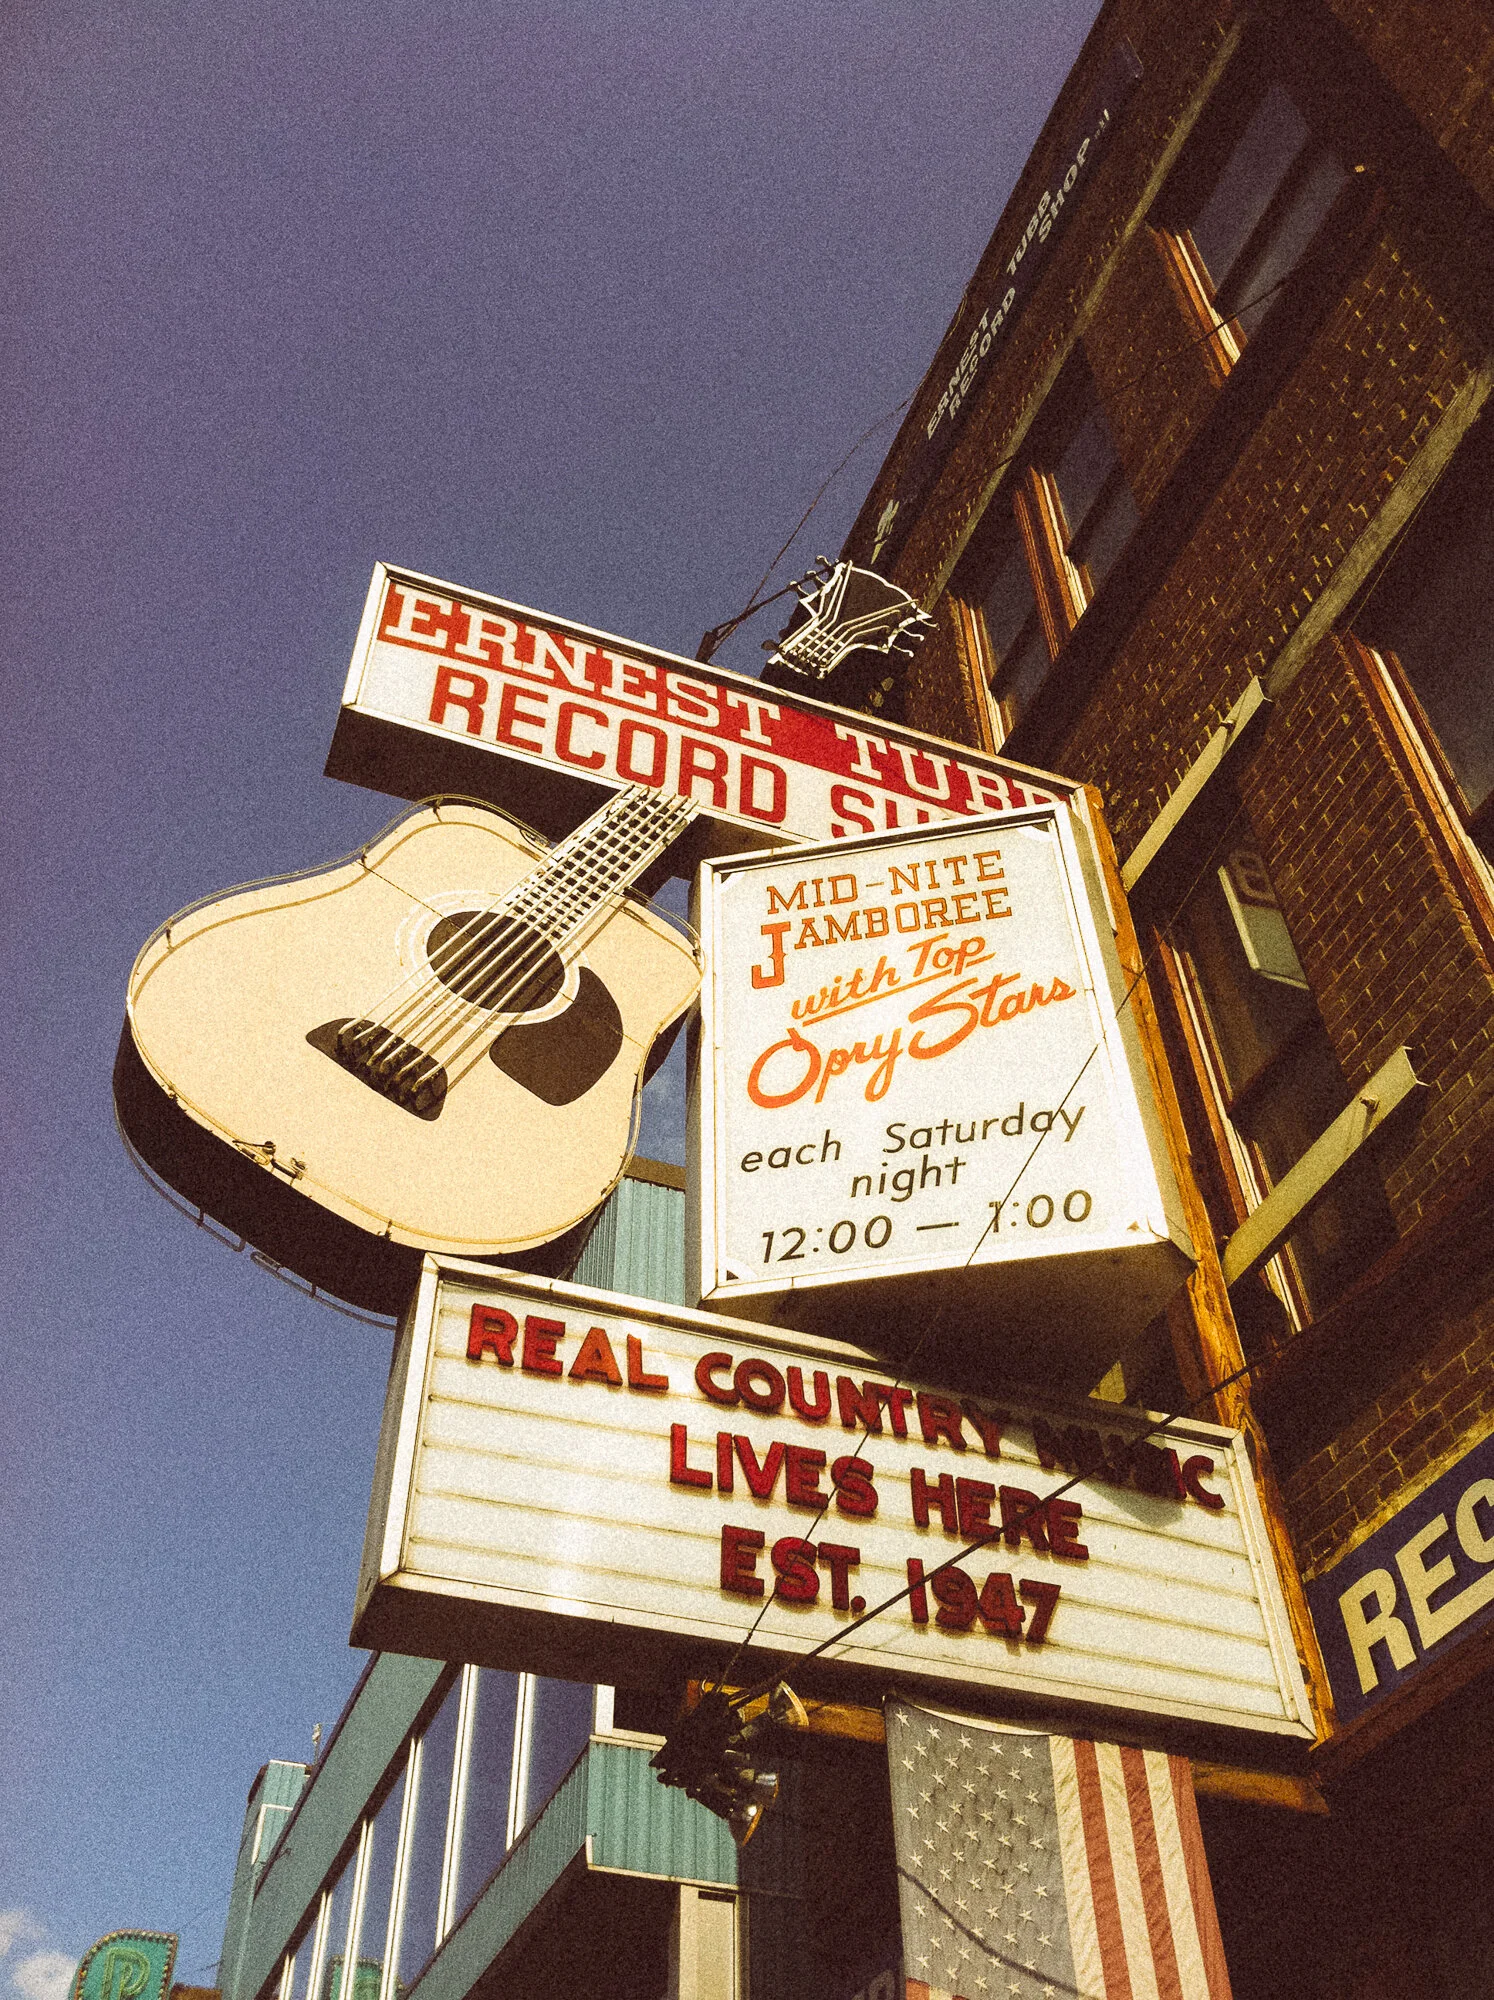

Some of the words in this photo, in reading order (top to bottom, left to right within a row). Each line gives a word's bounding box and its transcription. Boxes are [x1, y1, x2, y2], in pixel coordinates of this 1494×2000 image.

[927, 307, 989, 440] ERNEST
[1007, 191, 1051, 275] TUBB
[949, 287, 1016, 419] RECORD
[1039, 138, 1090, 244] SHOP
[385, 583, 782, 745] ERNEST
[428, 664, 787, 826] RECORD
[751, 888, 1013, 989] JAMBOREE
[791, 956, 901, 1020] with
[907, 933, 995, 977] Top
[748, 1027, 903, 1109] Opry
[908, 973, 1076, 1060] Stars
[741, 1130, 842, 1173] each
[882, 1101, 1085, 1154] Saturday
[850, 1155, 967, 1202] night
[762, 1215, 893, 1264] 12:00
[989, 1189, 1093, 1234] 1:00
[466, 1303, 669, 1390] REAL
[695, 1352, 1005, 1458] COUNTRY
[669, 1422, 879, 1518] LIVES
[909, 1467, 1090, 1560] HERE
[720, 1524, 867, 1612] EST.
[906, 1557, 1062, 1644] 1947
